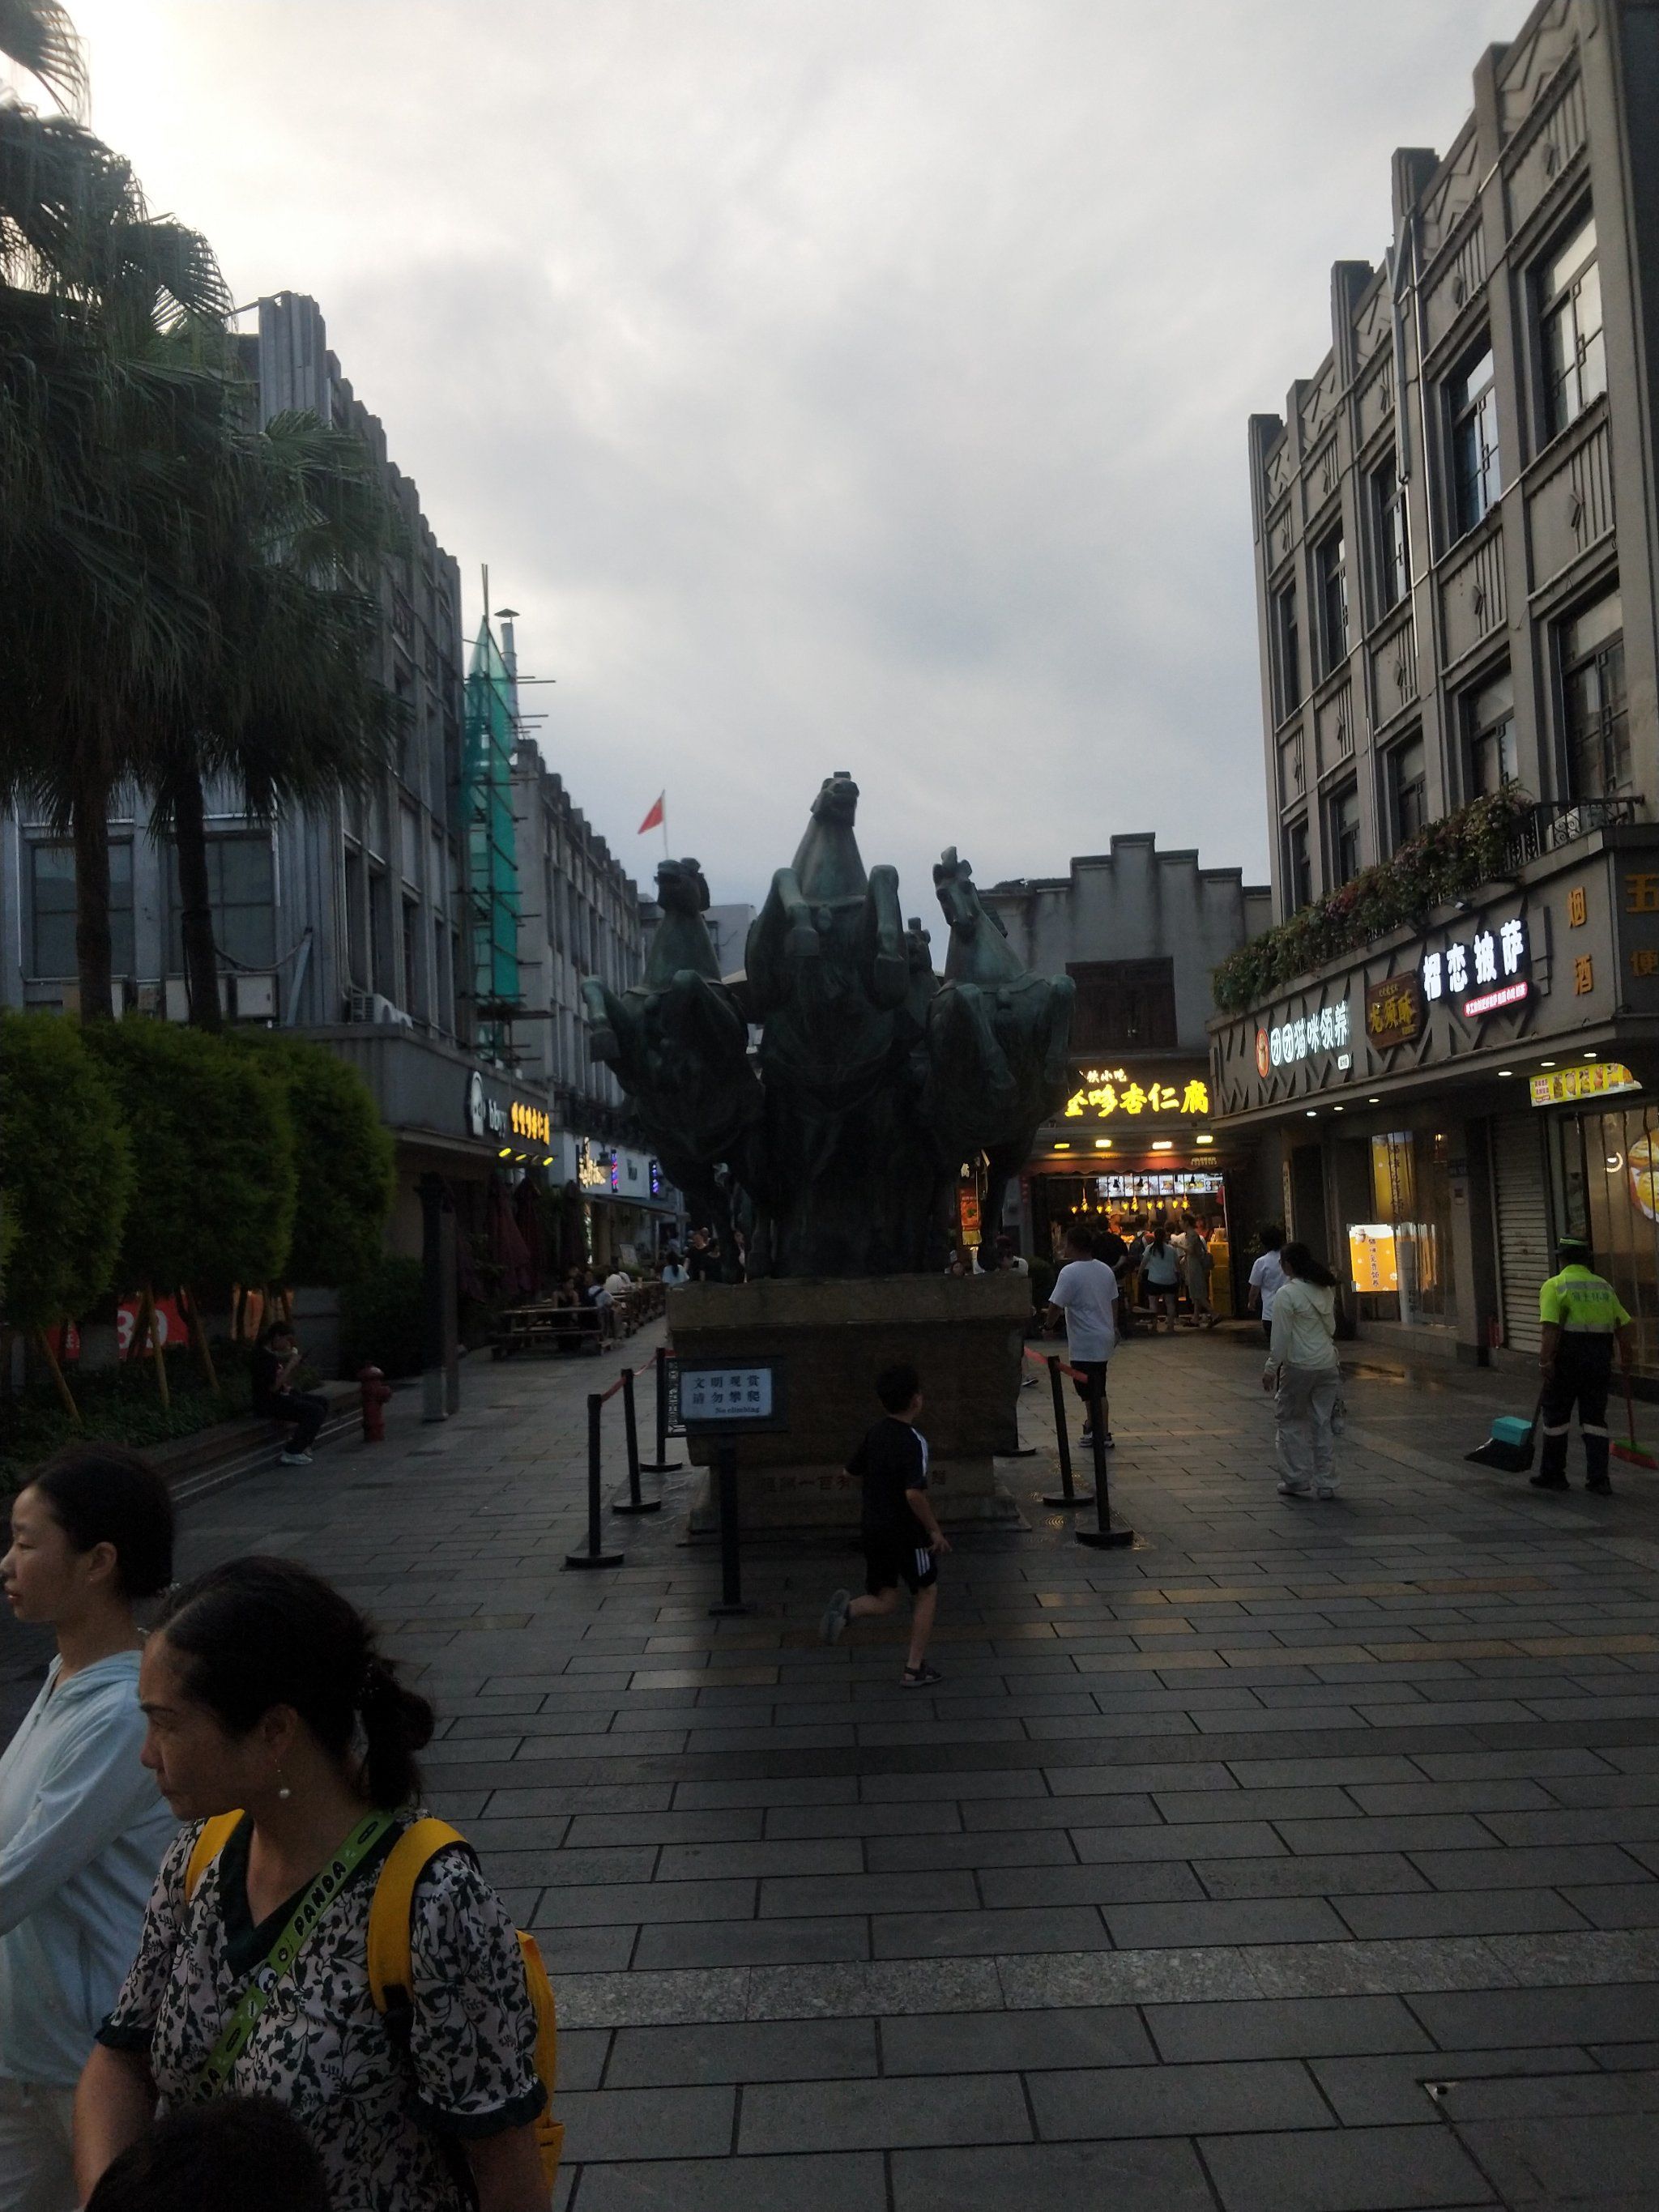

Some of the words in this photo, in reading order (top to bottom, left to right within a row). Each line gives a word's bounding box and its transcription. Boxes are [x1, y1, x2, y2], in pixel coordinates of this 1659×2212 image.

[1625, 874, 1659, 913] 五
[1567, 886, 1593, 995] 烟酒
[1270, 999, 1349, 1067] 团团猫咪领养
[1079, 1067, 1128, 1083] 饮小吃
[693, 1375, 760, 1388] 文明观赏
[693, 1391, 760, 1404] 请勿攀爬
[727, 1406, 760, 1414] climbing
[294, 1860, 347, 1937] PANDA
